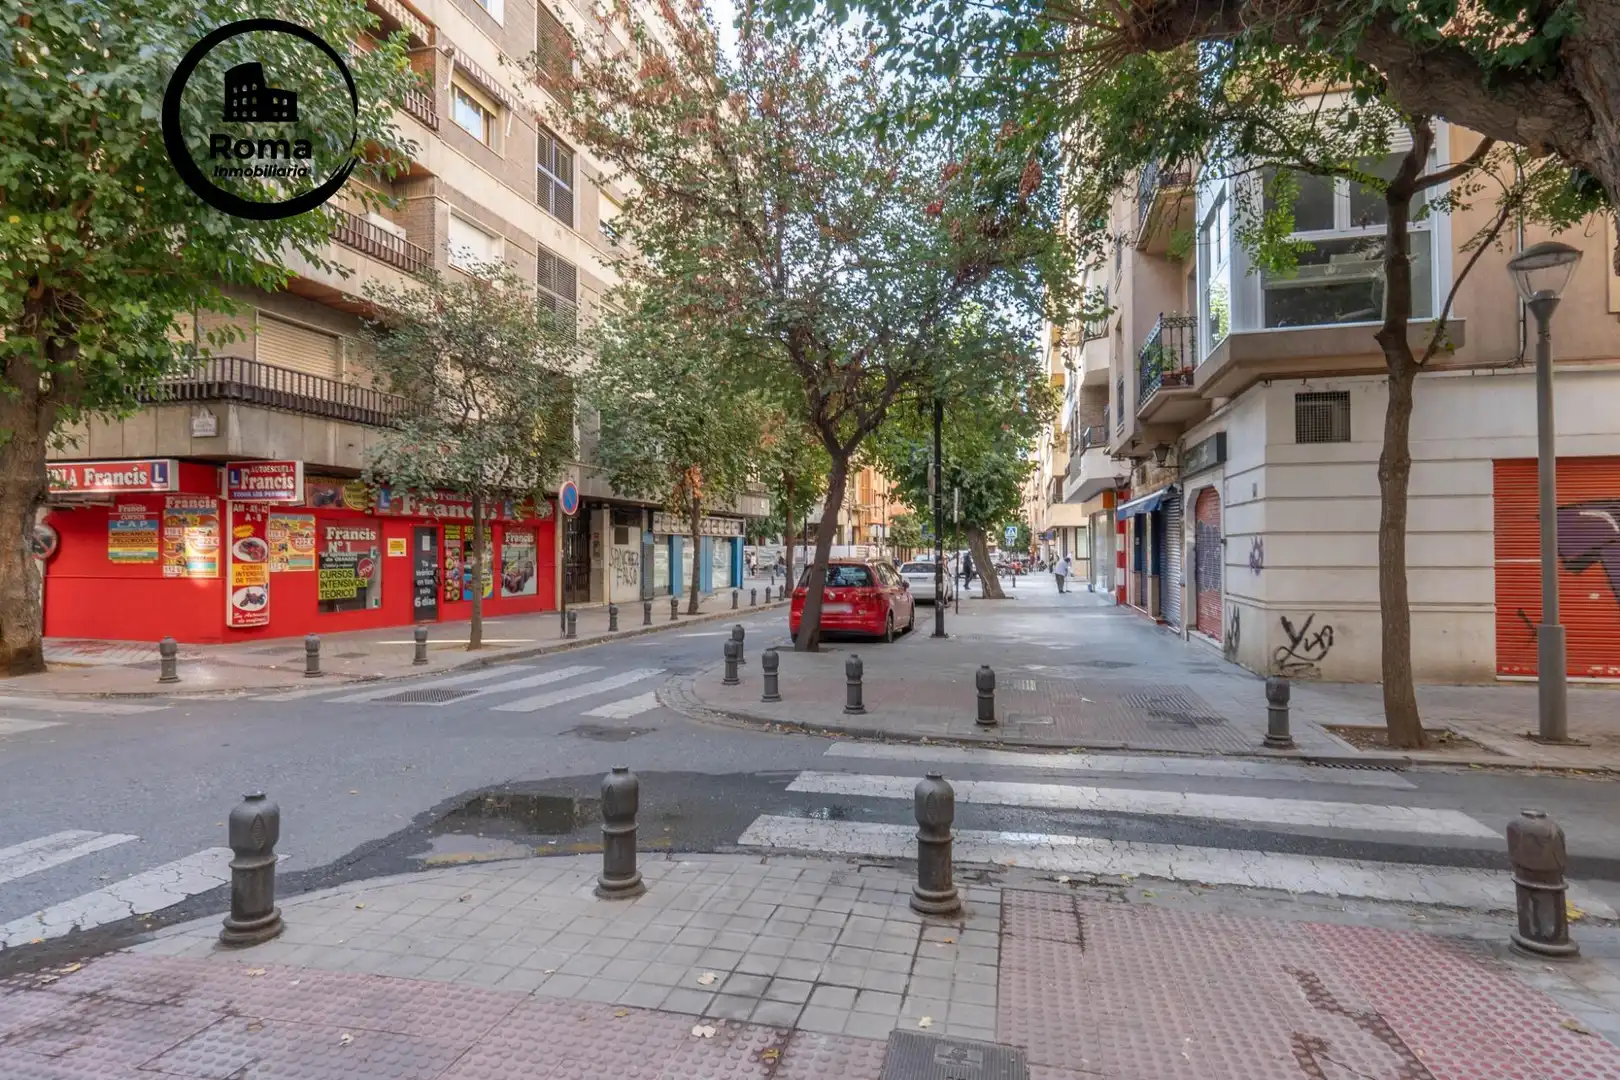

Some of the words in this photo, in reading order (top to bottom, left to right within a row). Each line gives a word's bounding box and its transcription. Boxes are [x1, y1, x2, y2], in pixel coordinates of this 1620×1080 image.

[250, 464, 295, 473] AUTOESCUELA
[83, 464, 148, 487] Francis
[154, 463, 164, 482] L
[231, 470, 239, 484] L
[240, 468, 295, 490] Francis
[164, 496, 217, 508] Francis
[400, 493, 498, 520] Francis
[118, 504, 147, 513] Francis
[326, 527, 377, 541] Francis
[505, 532, 534, 543] Francis
[320, 570, 353, 579] CURSOS
[360, 563, 374, 577] STOP
[320, 579, 366, 588] INTENSIVOS
[415, 597, 421, 607] 6
